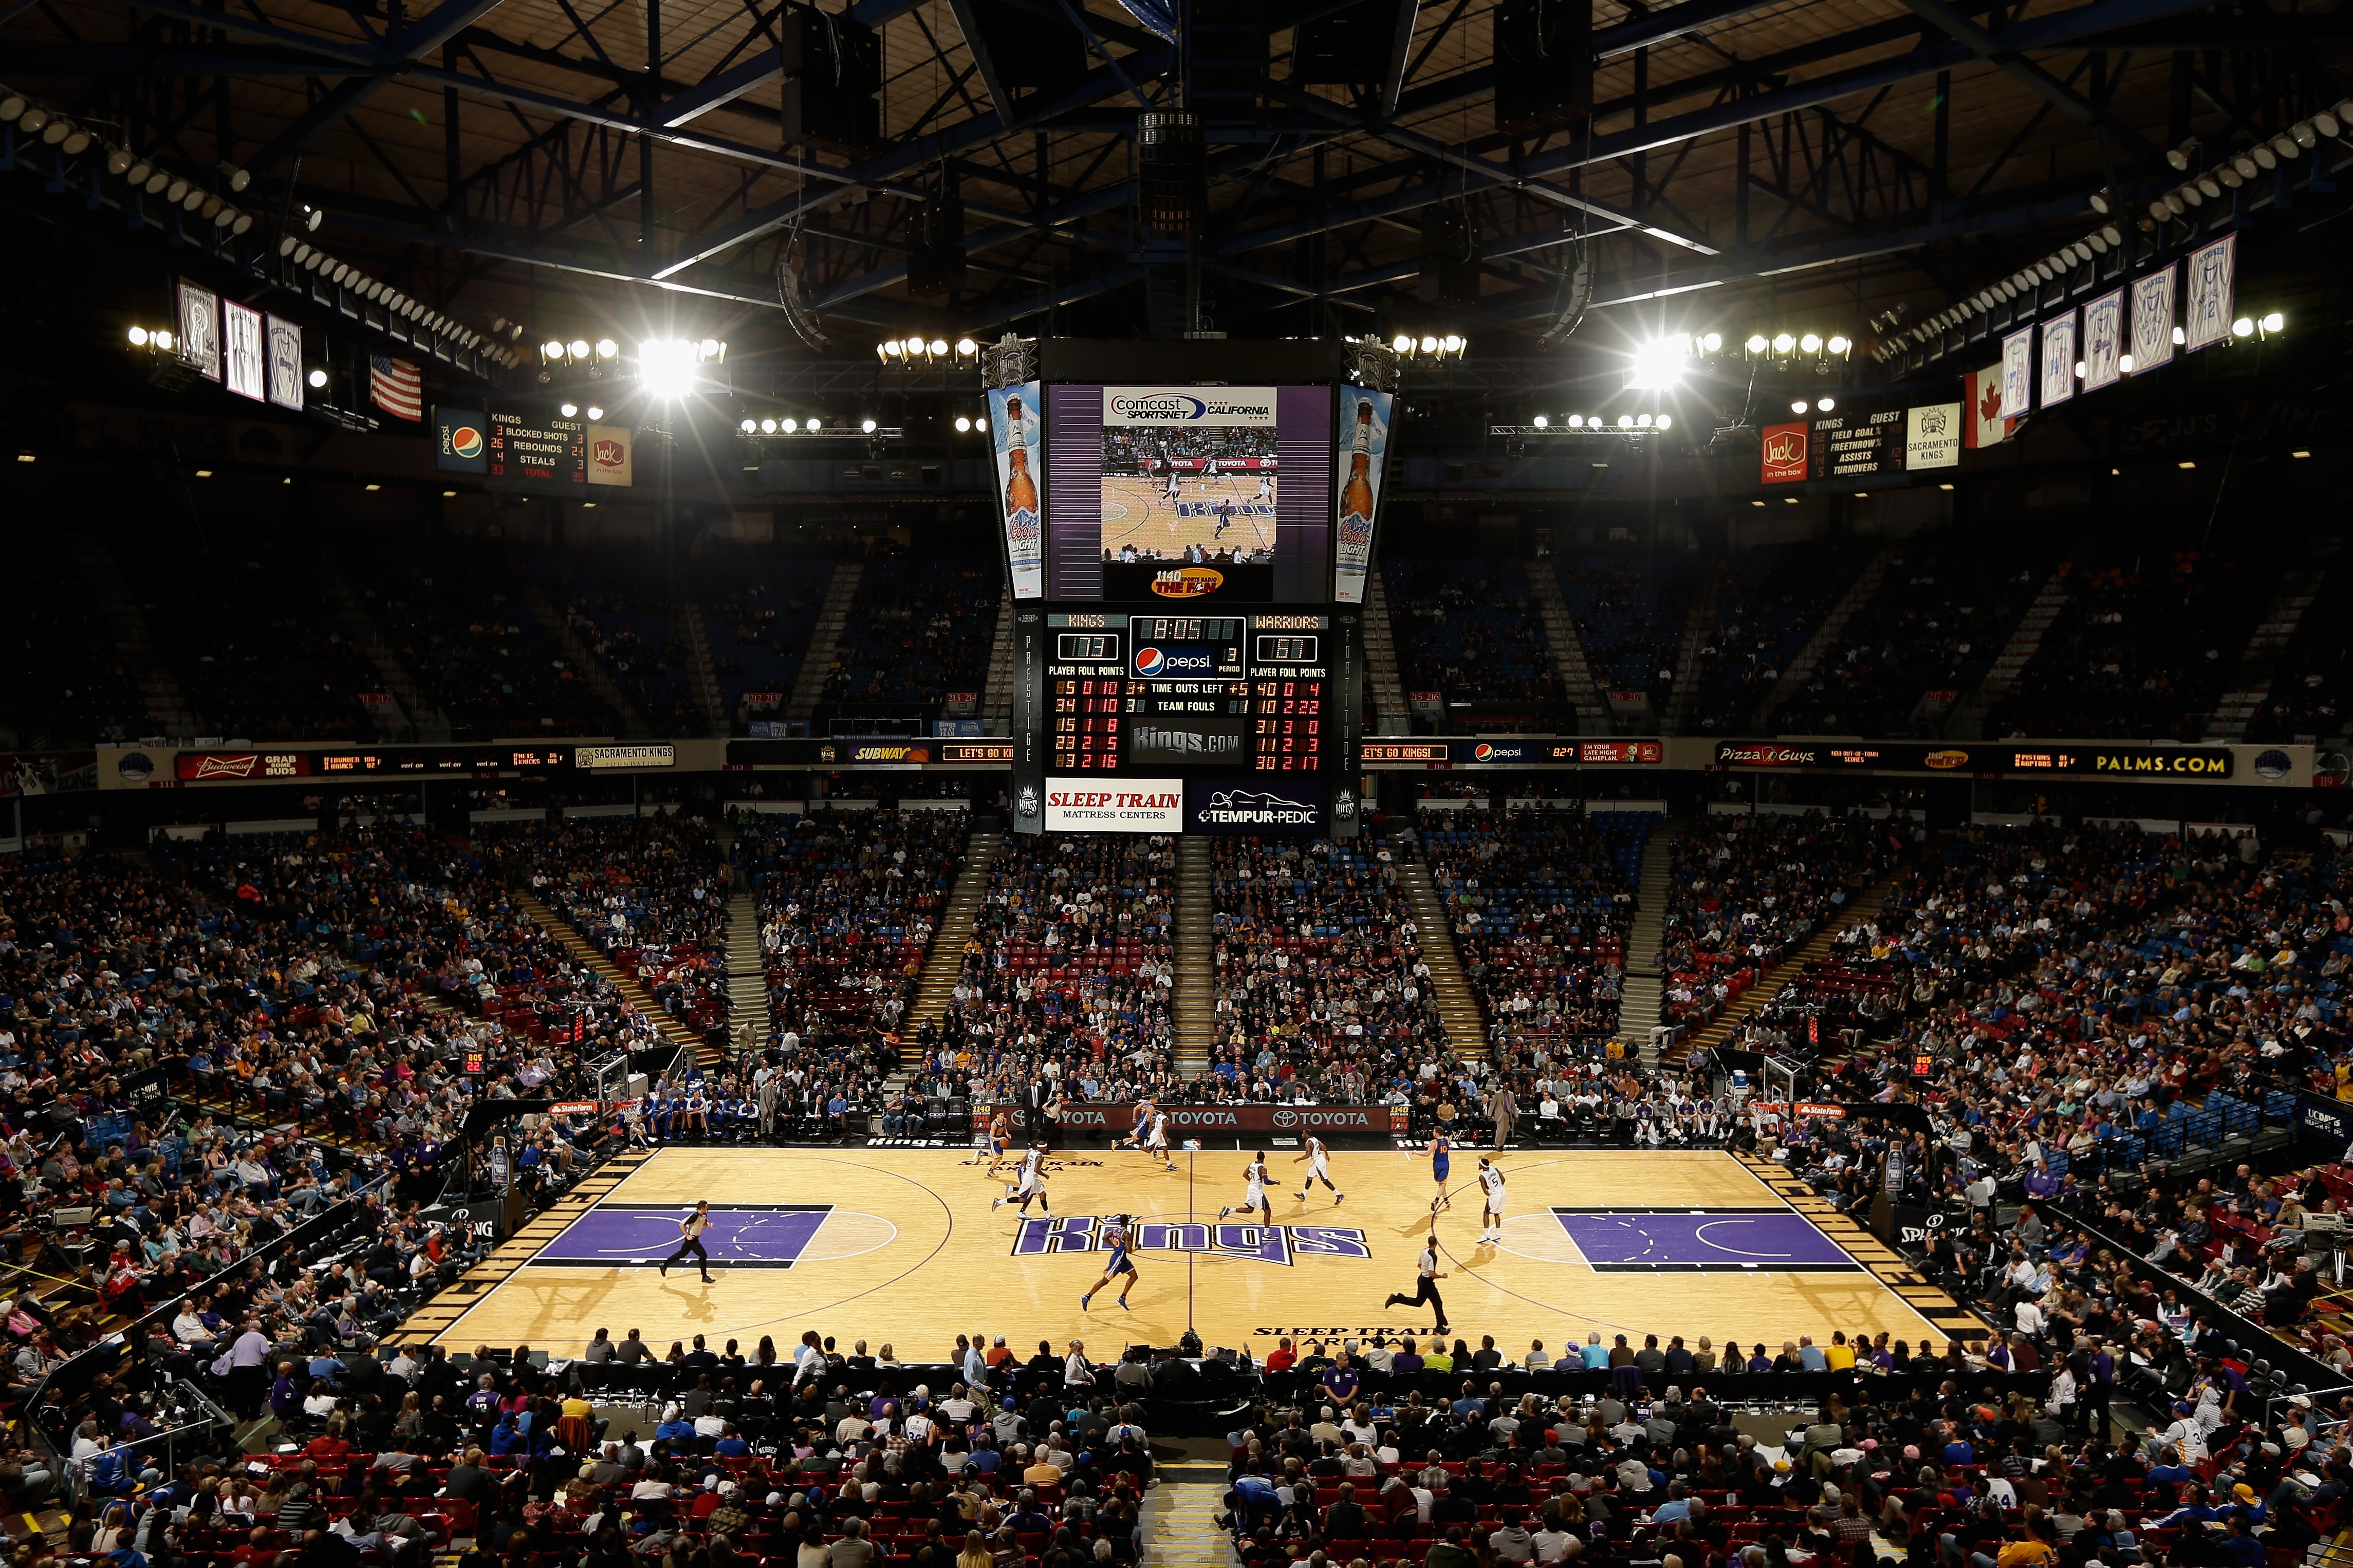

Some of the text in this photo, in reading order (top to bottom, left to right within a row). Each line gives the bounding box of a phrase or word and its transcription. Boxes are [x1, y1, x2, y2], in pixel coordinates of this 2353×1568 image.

[2203, 301, 2215, 320] 12
[231, 312, 256, 329] BOLTON
[2146, 327, 2157, 345] 11
[1116, 398, 1181, 410] comcast
[1127, 410, 1189, 419] SPORTSNET
[1208, 406, 1269, 415] CALIFORNIA
[492, 414, 521, 424] KINGS
[1870, 412, 1900, 424] GUEST
[497, 425, 503, 436] 3
[552, 421, 581, 431] GUEST
[1815, 418, 1844, 431] KINGS
[506, 427, 568, 441] BLOCKED SHOTS
[578, 434, 583, 444] 3
[1831, 429, 1852, 440] FIELD
[491, 438, 503, 449] 26
[514, 441, 562, 453] REBOUNDS
[1766, 436, 1805, 463] Jack
[1908, 439, 1958, 452] SACRAMENTO
[497, 452, 503, 461] 4
[595, 443, 623, 463] Jack
[1839, 451, 1872, 463] ASSISTS
[1921, 451, 1943, 460] KINGS
[520, 456, 555, 466] STEALS
[578, 460, 583, 470] 3
[1907, 458, 1958, 468] FOUNDATION
[525, 468, 551, 478] TOTAL
[1833, 463, 1878, 475] TURNOVERS
[1011, 520, 1038, 540] Coors
[1341, 523, 1368, 545] Coors
[1012, 539, 1037, 552] LIGHT
[1339, 543, 1366, 556] LIGHT
[1156, 571, 1181, 582] 1140
[1156, 582, 1217, 593] THE FAN
[1069, 615, 1105, 627] KINGS
[1255, 616, 1320, 628] WARRIORS
[1154, 619, 1203, 639] 8:05
[1276, 639, 1304, 659] 67
[1049, 666, 1124, 676] PLAYER FOUL POINTS
[1250, 668, 1326, 677] PLAYER FOUL POINTS
[1066, 681, 1118, 695] 5 10
[1152, 684, 1223, 693] TIME OUTS LEFT
[1257, 682, 1276, 696] 40
[376, 695, 391, 703] 212
[1056, 699, 1118, 713] 34 10
[1158, 702, 1215, 711] TEAM FOULS
[1262, 700, 1319, 714] 10 22
[1061, 718, 1076, 732] 15
[1256, 720, 1276, 734] 31
[595, 748, 672, 758] SACRAMENTO KINGS
[855, 746, 912, 760] SUBWAY
[959, 748, 999, 758] LET'S GO
[1387, 748, 1431, 757] GO KINGS!
[1720, 748, 1815, 763] Pizza Guys
[265, 755, 297, 763] GRAB
[1255, 756, 1318, 770] 30 17
[2097, 756, 2226, 773] PALMS.COM
[197, 761, 254, 772] Budweiser
[2320, 776, 2333, 787] 119
[1019, 799, 1037, 812] KINGS
[1048, 792, 1181, 808] SLEEP TRAIN
[1336, 802, 1354, 814] KINGS
[1063, 810, 1166, 819] MATTRESS CENTERS
[1211, 810, 1316, 823] TEMPUR-PEDIC
[467, 1061, 480, 1072] 22
[1915, 1064, 1928, 1074] 22
[561, 1104, 592, 1112] StateFarm
[1810, 1106, 1842, 1115] StateFarm
[1171, 1112, 1237, 1125] TOYOTA
[1299, 1112, 1368, 1125] TOYOTA
[866, 1138, 985, 1147] Kings.com
[1492, 1177, 1498, 1187] 5
[1011, 1214, 1373, 1266] Kings
[1253, 1328, 1347, 1336] SLEEP
[2193, 1431, 2207, 1445] 30
